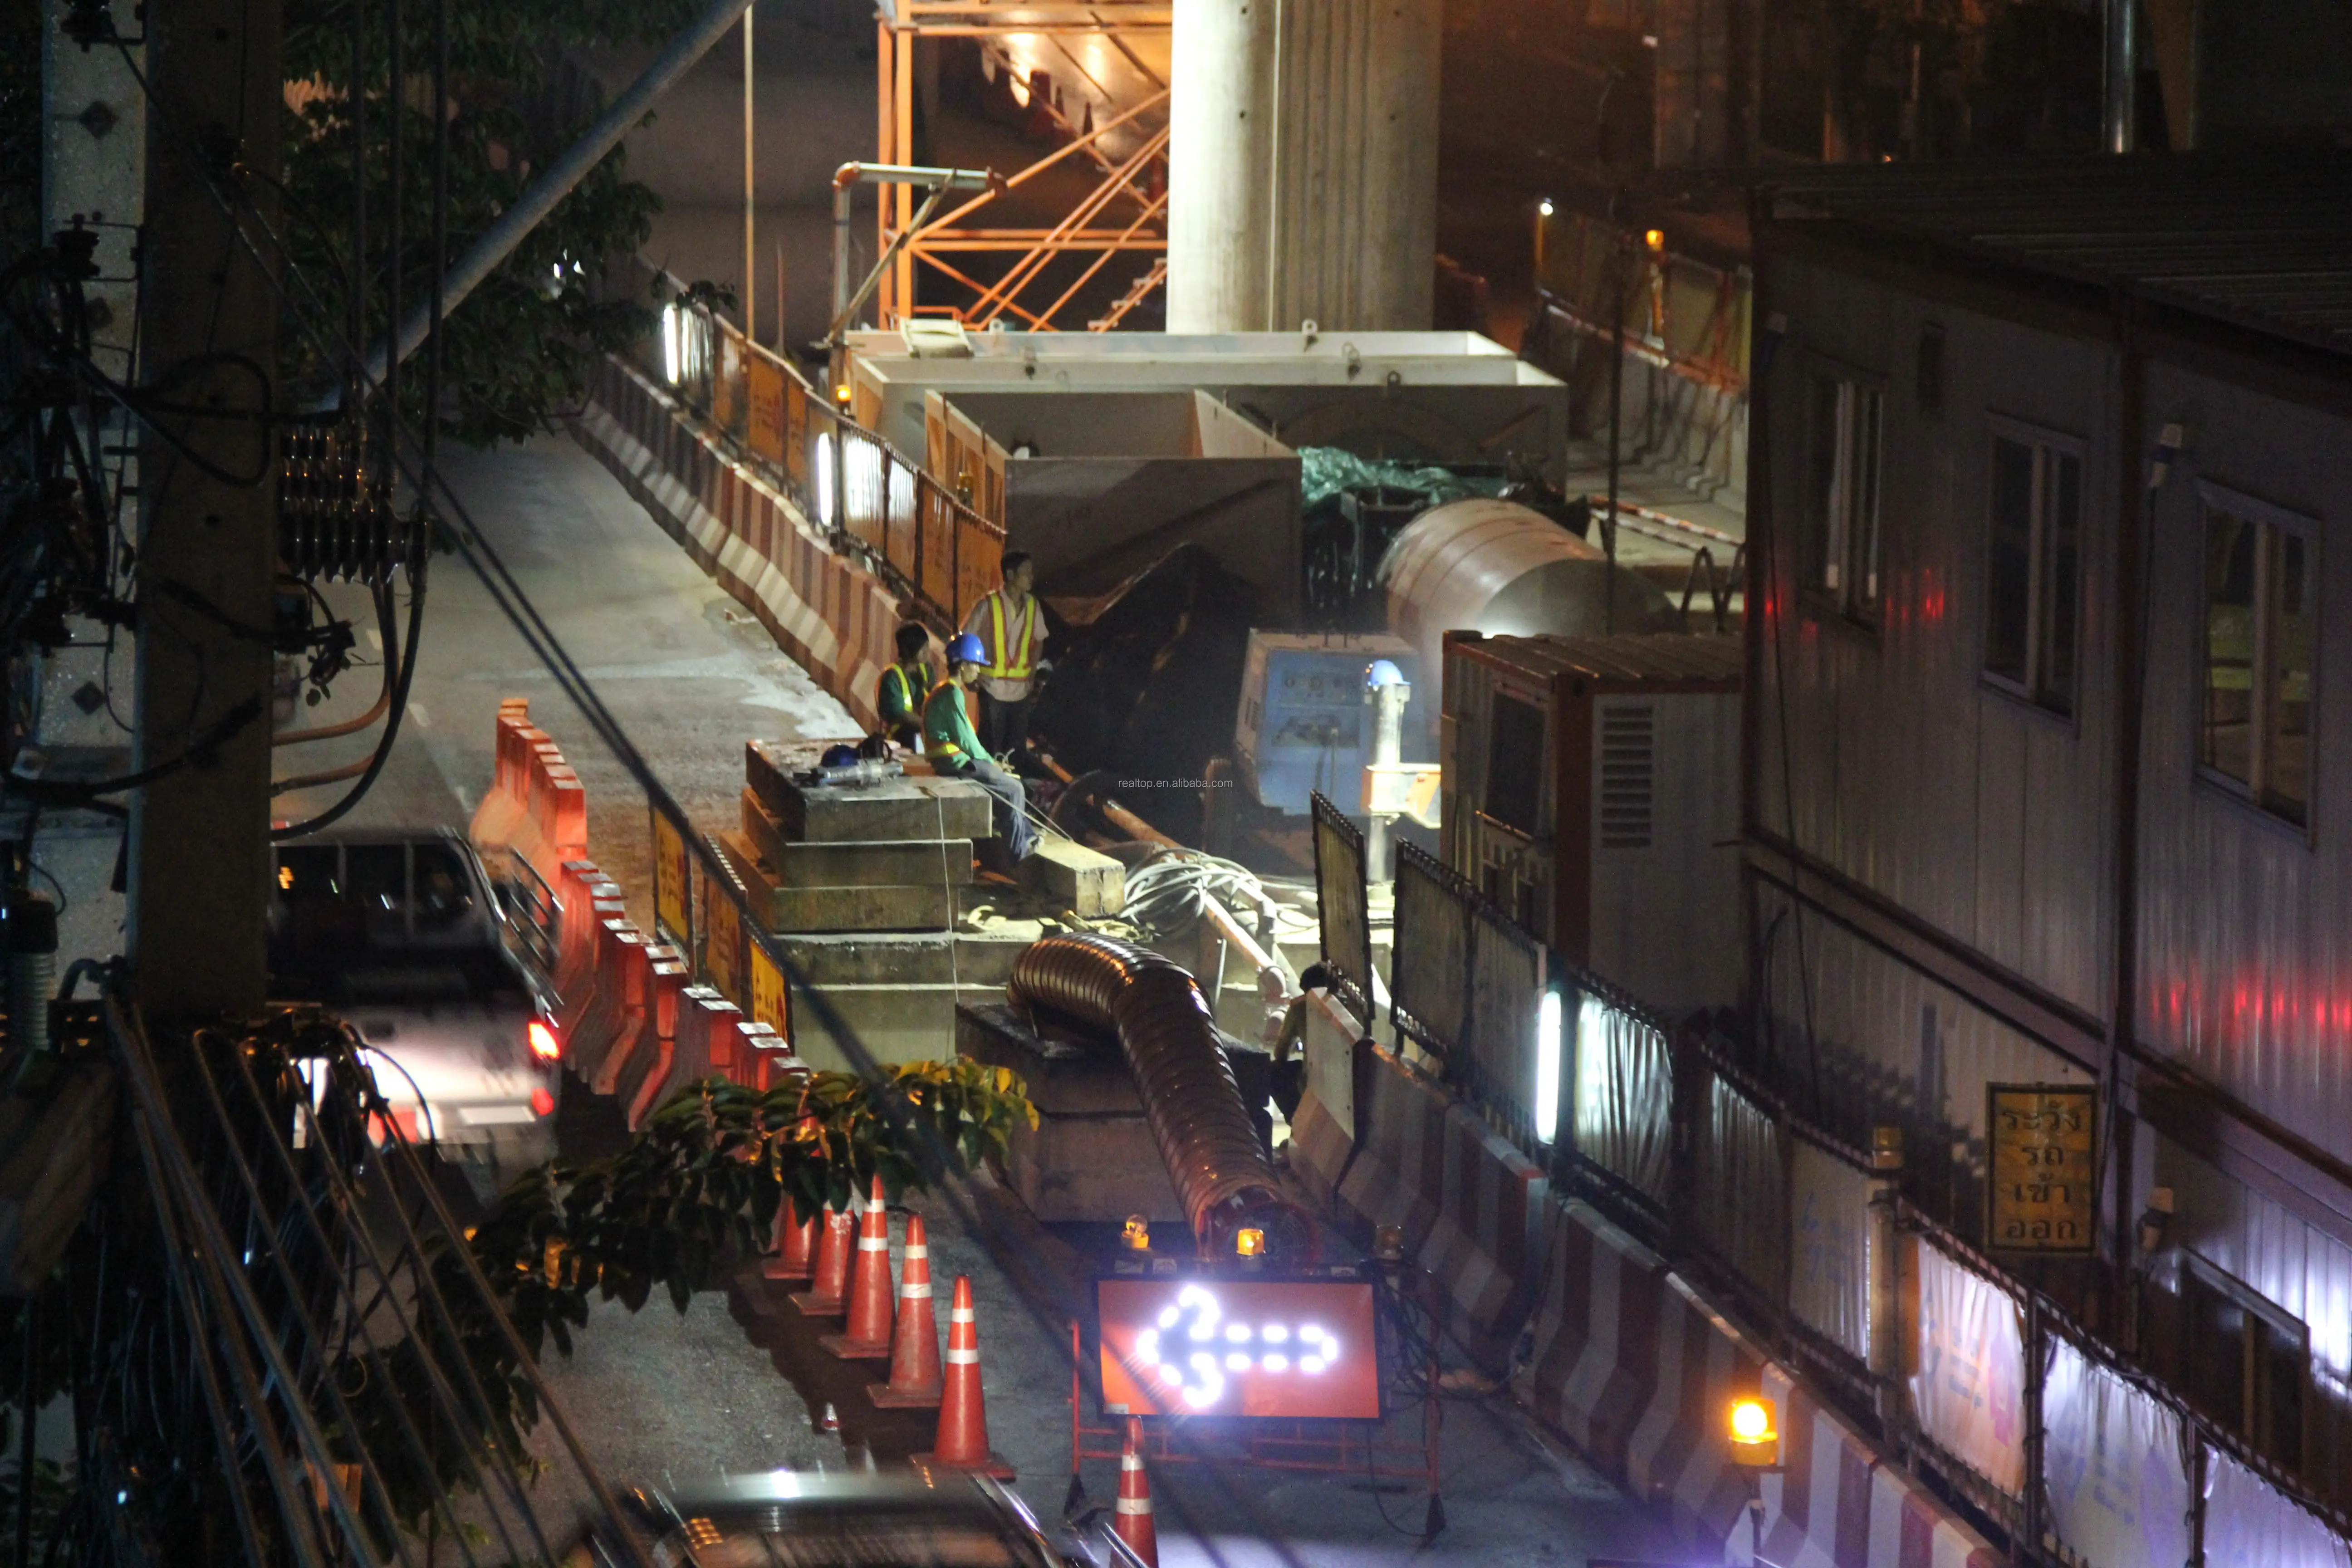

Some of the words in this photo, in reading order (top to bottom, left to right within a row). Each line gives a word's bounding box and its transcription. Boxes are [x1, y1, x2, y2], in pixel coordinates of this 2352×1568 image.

[2002, 1100, 2080, 1131] ระวัง
[2021, 1146, 2064, 1166] รถ
[2015, 1173, 2070, 1203] เข้า
[2006, 1219, 2076, 1239] ออก
